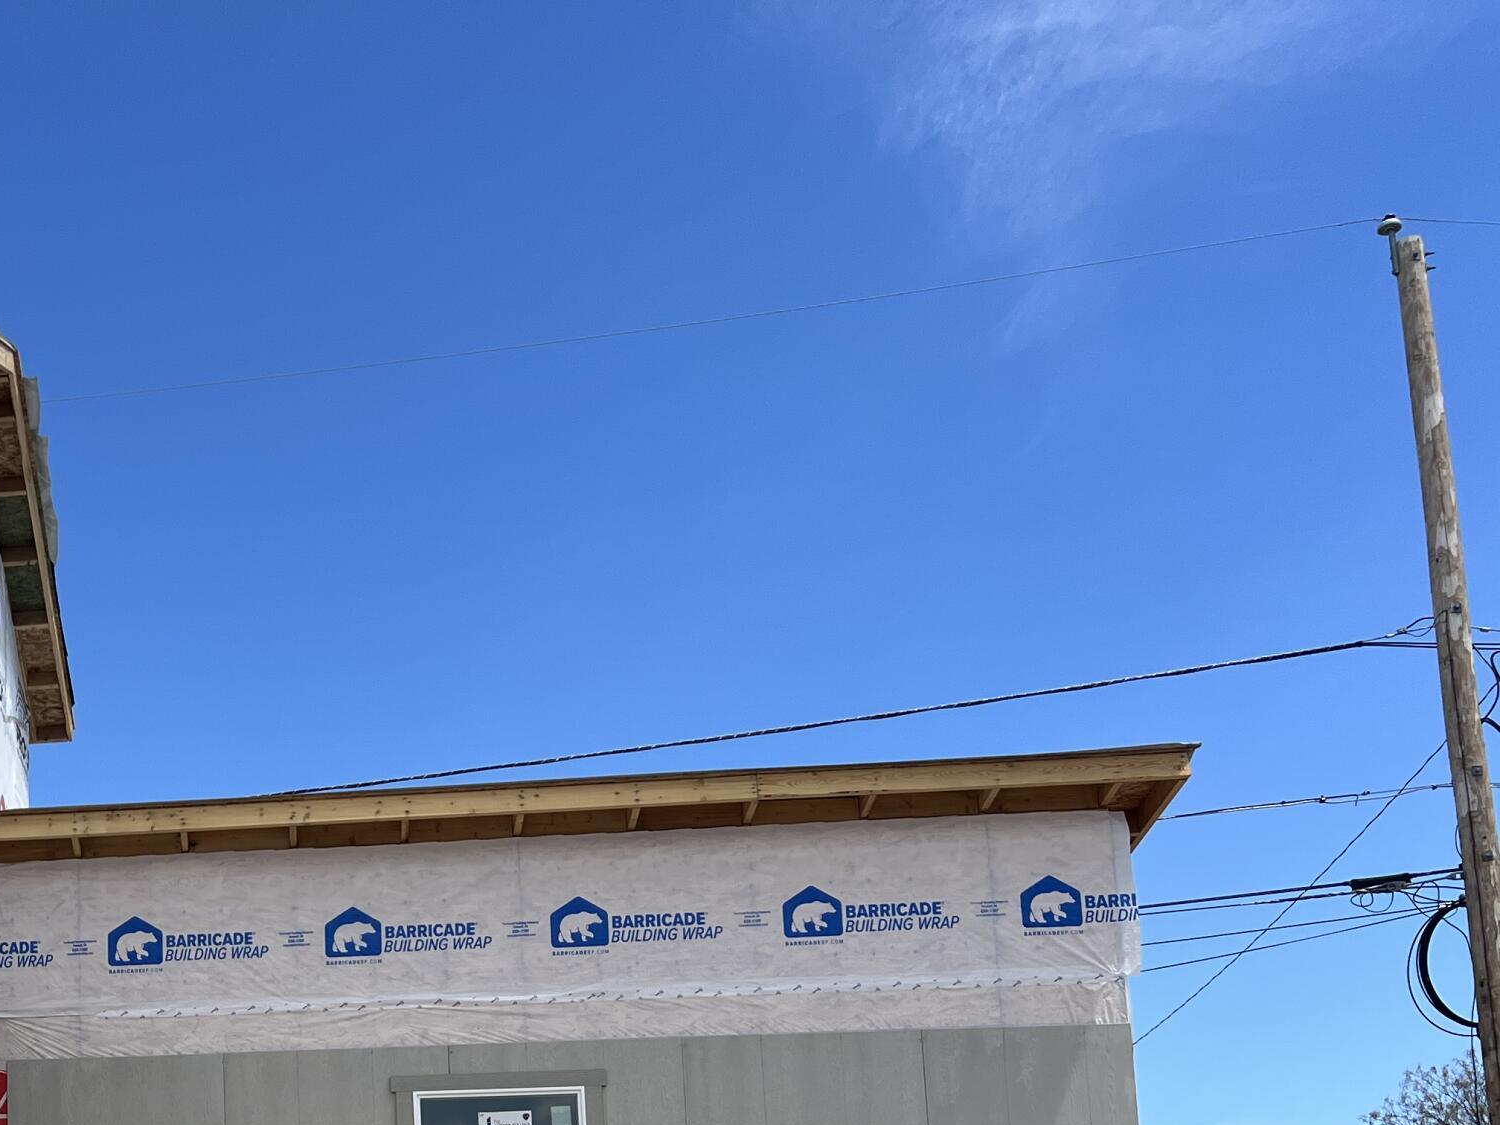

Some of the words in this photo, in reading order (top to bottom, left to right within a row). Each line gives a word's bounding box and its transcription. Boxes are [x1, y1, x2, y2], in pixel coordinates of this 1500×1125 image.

[845, 901, 942, 918] BARRICADE
[1085, 893, 1137, 909] BARRI
[611, 912, 706, 928] BARRICADE
[844, 917, 914, 933] BUILDING
[917, 915, 961, 930] WRAP
[384, 922, 476, 939] BARRICADE
[610, 927, 678, 943] BUILDING
[681, 925, 724, 939] WRAP
[165, 932, 253, 948] BARRICADE
[383, 938, 451, 953] BUILDING
[452, 936, 493, 951] WRAP
[15, 954, 55, 968] WRAP
[165, 947, 227, 962] BUILDING
[229, 945, 270, 959] WRAP
